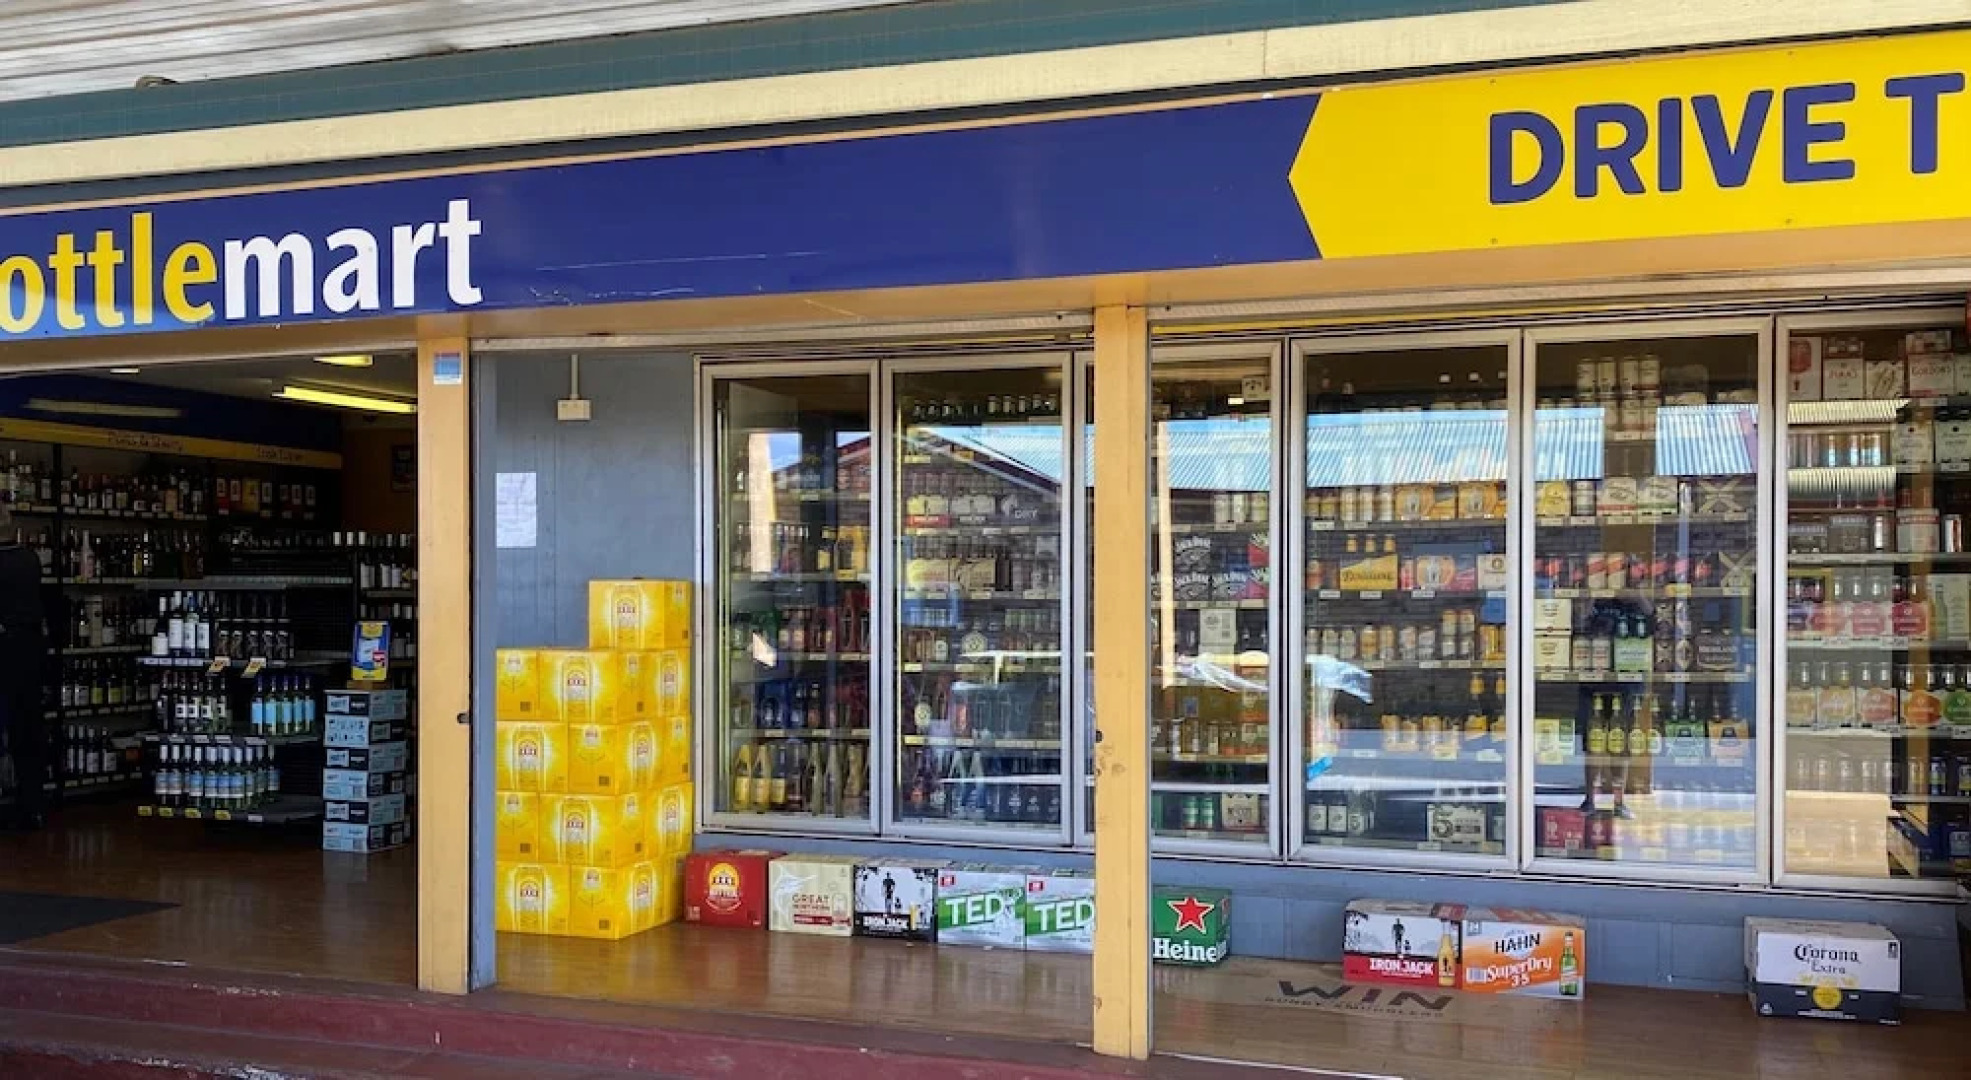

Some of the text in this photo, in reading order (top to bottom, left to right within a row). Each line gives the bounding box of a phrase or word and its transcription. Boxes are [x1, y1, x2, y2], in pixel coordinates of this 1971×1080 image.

[1488, 80, 1857, 206] DRIVE
[792, 893, 830, 904] GREAT
[1494, 932, 1541, 954] HAHN
[1794, 943, 1862, 965] Corona
[1369, 957, 1400, 971] IRON
[1402, 961, 1434, 976] JACK
[1811, 961, 1846, 974] Extra
[1278, 980, 1454, 1011] WIN
